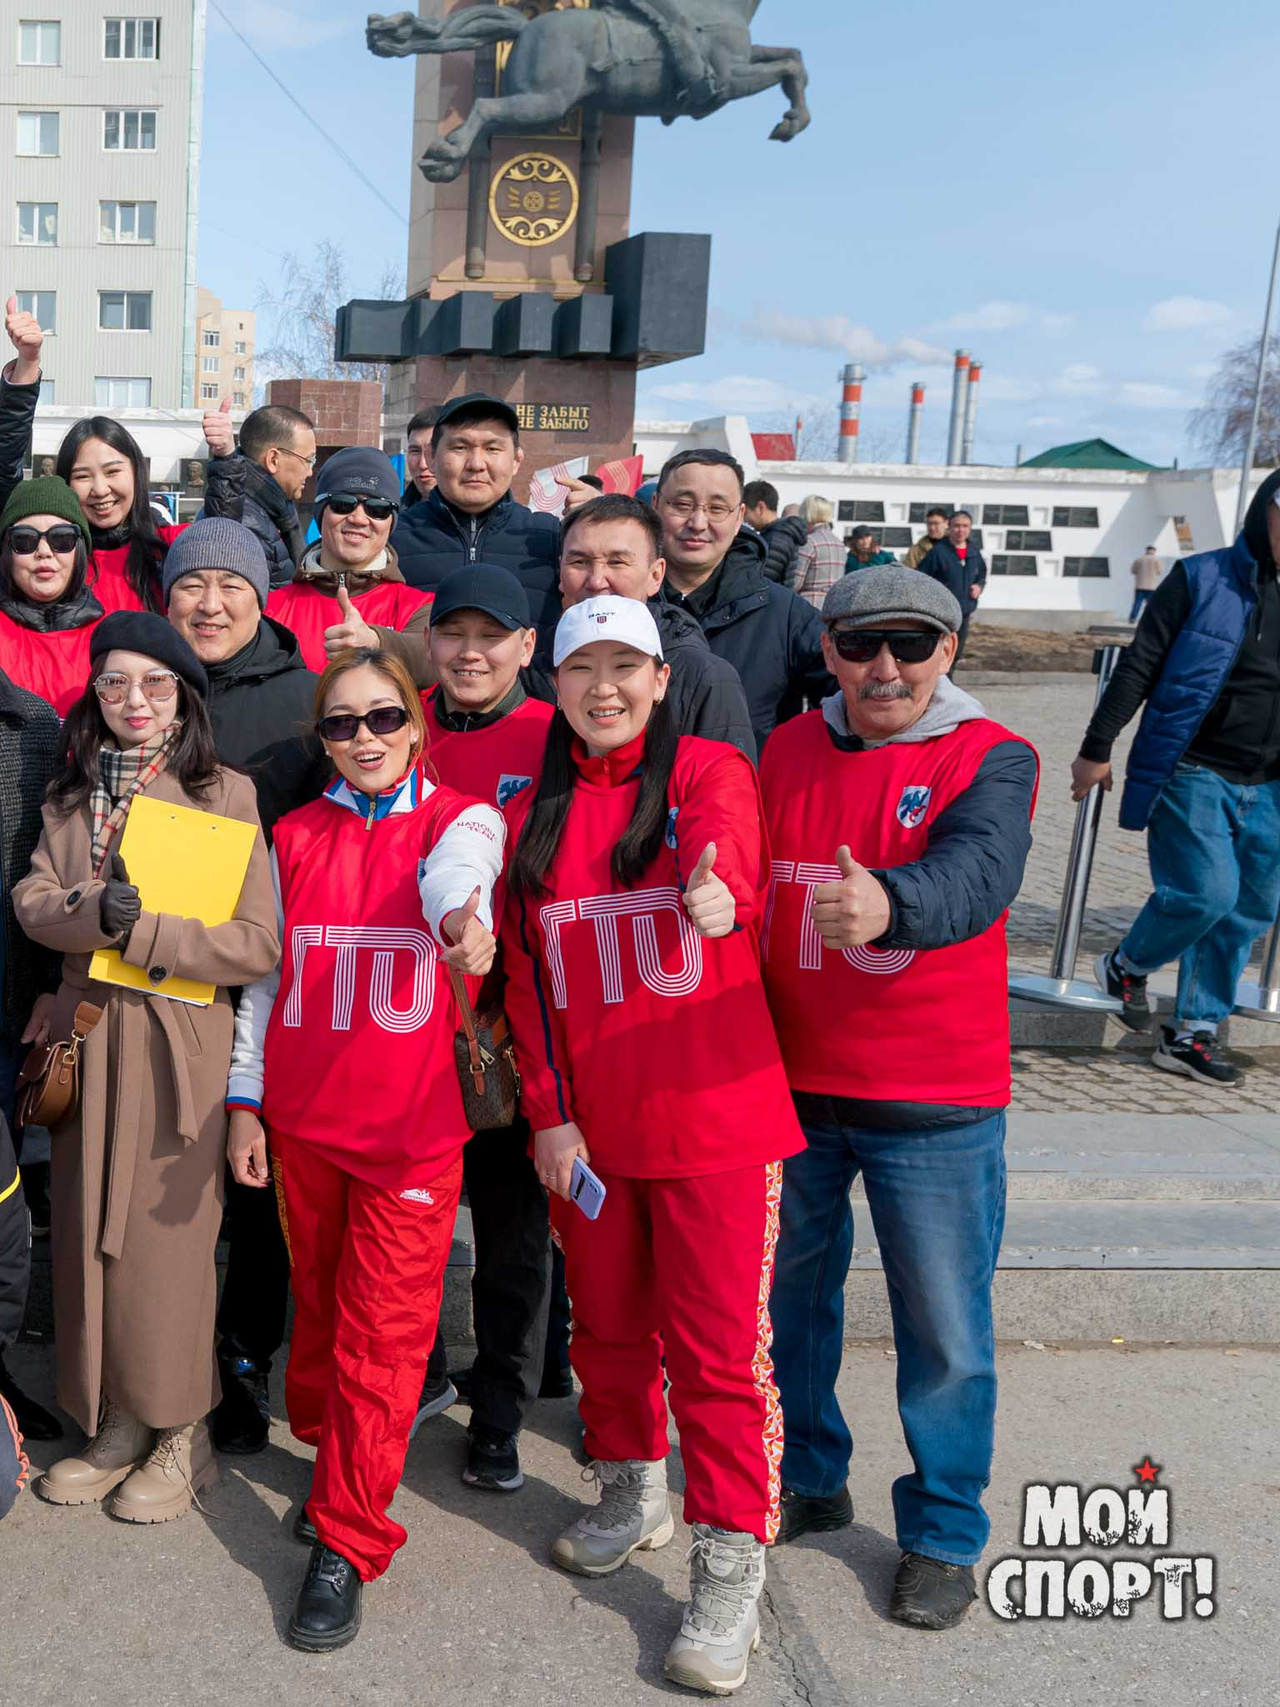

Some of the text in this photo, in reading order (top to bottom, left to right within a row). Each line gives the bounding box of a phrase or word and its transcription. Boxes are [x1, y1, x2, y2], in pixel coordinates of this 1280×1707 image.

[516, 404, 535, 416] НЕ
[518, 416, 588, 430] НЕ ЗАБЫТО
[539, 886, 703, 1009] ГТО
[283, 924, 437, 1034] ГТО
